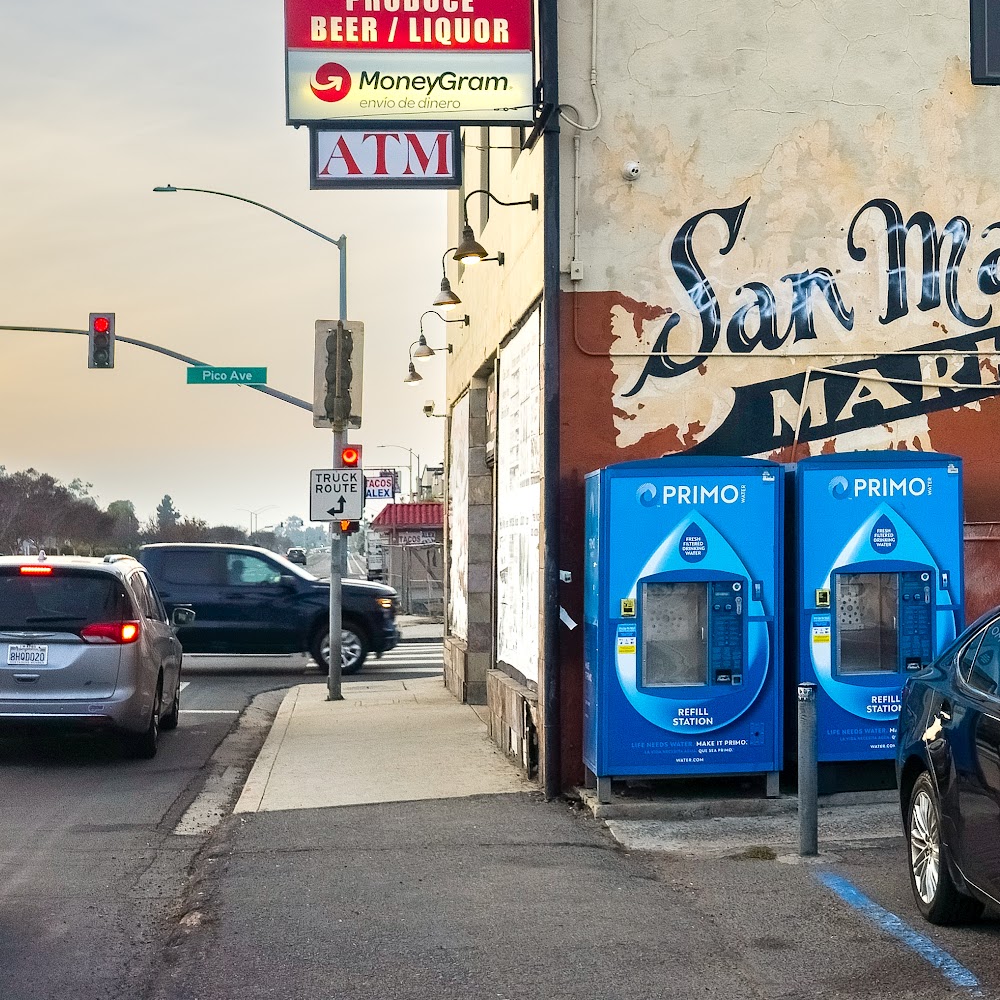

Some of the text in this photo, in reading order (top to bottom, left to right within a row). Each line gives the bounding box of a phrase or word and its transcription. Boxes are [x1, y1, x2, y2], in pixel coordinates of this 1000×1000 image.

[310, 16, 378, 42] BEER
[408, 17, 510, 45] LIQUOR
[358, 71, 509, 96] MoneyGram
[398, 97, 416, 109] de
[417, 97, 461, 109] dinero
[319, 133, 451, 176] ATM
[620, 196, 855, 398] San
[202, 370, 253, 381] Pico Ave
[315, 473, 358, 482] TRUCK
[315, 484, 358, 493] ROUTE
[854, 477, 926, 497] PRIMO
[366, 488, 391, 498] ALEX
[662, 484, 739, 505] PRIMO
[871, 695, 901, 704] REFILL
[677, 707, 709, 716] REFILL
[672, 716, 714, 726] STATION
